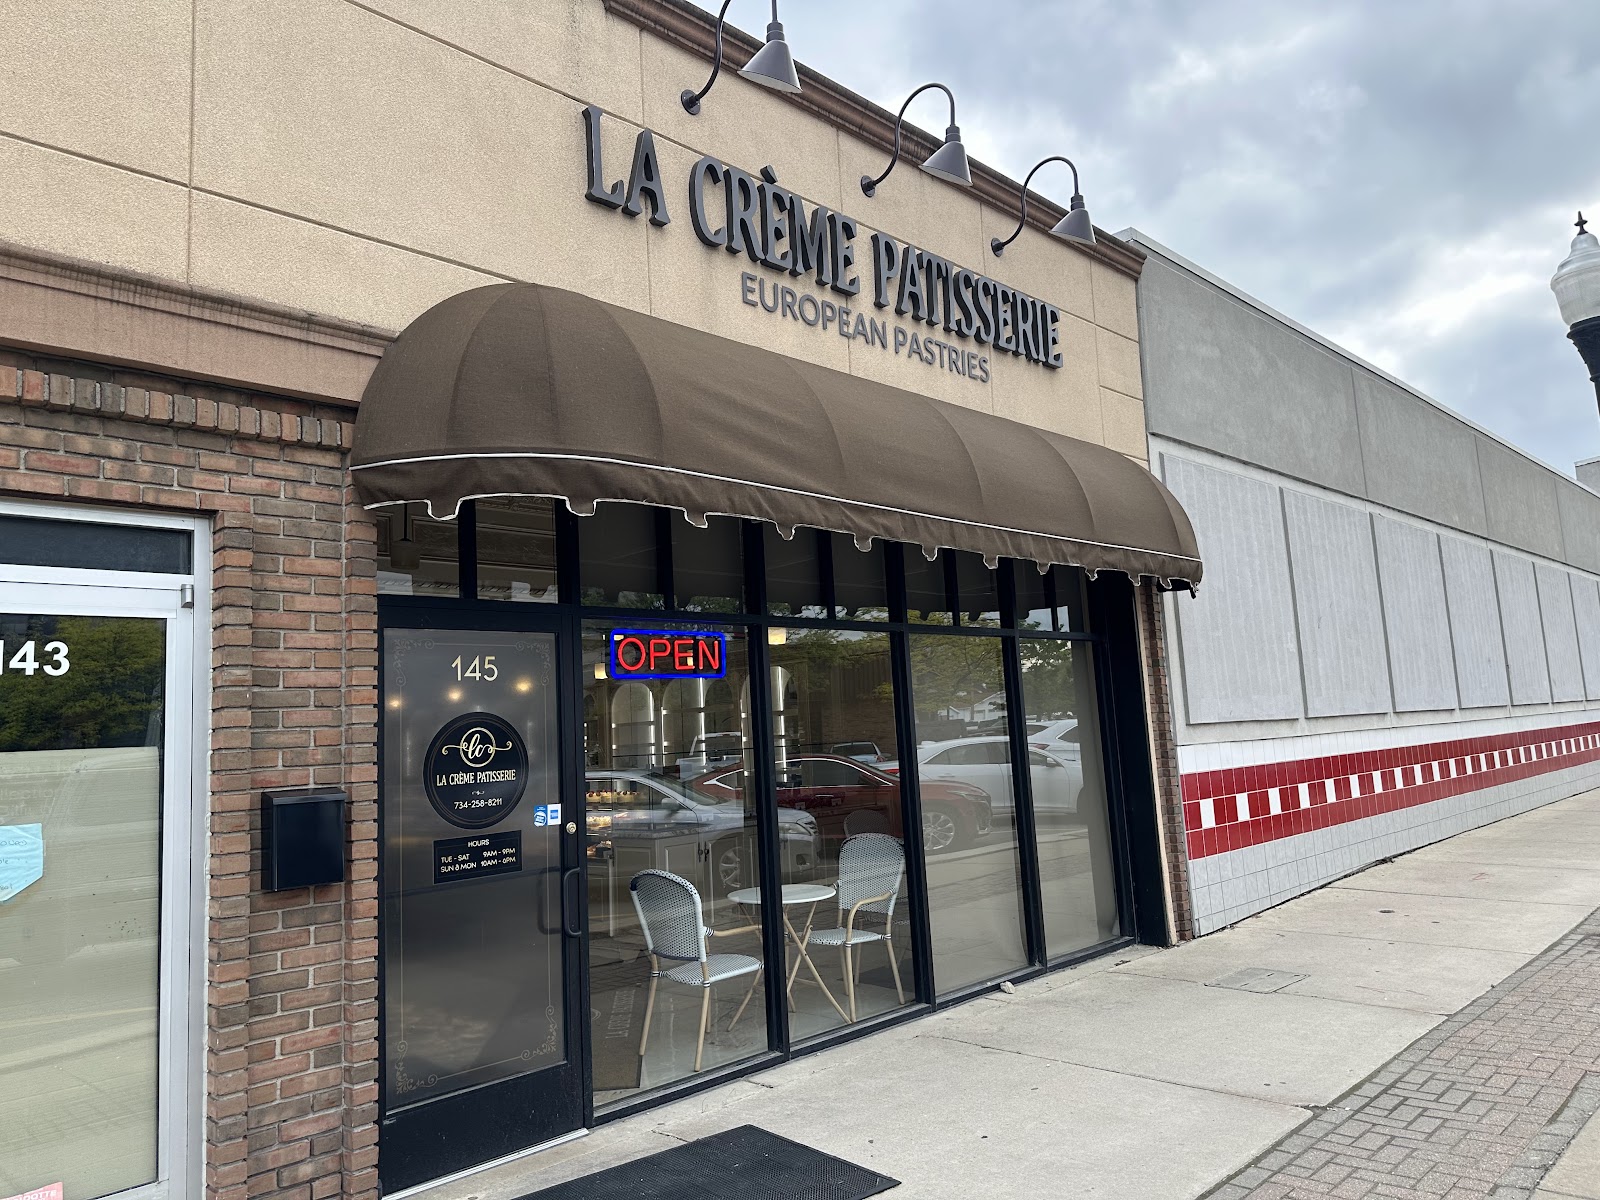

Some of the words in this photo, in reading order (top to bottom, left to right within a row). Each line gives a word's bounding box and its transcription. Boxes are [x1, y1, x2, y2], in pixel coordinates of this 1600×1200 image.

[582, 105, 671, 228] LA
[689, 156, 860, 297] CRÈME
[871, 231, 1063, 369] PATISSERIE
[742, 271, 888, 350] EUROPEAN
[894, 325, 990, 383] PASTRIES
[617, 637, 720, 671] OPEN
[450, 655, 498, 682] 145
[436, 774, 447, 787] LA
[449, 771, 475, 786] CRÈME
[476, 769, 517, 783] PATISSERIE
[453, 798, 503, 810] 734-258-8211
[467, 839, 490, 848] HOURS
[440, 856, 453, 864] TUE
[457, 853, 471, 862] SAT
[482, 849, 498, 858] 9AM
[502, 847, 516, 856] 9PM
[440, 864, 455, 873] SUN
[460, 862, 477, 871] MON
[480, 858, 498, 867] 10AM
[502, 856, 516, 865] 6PM
